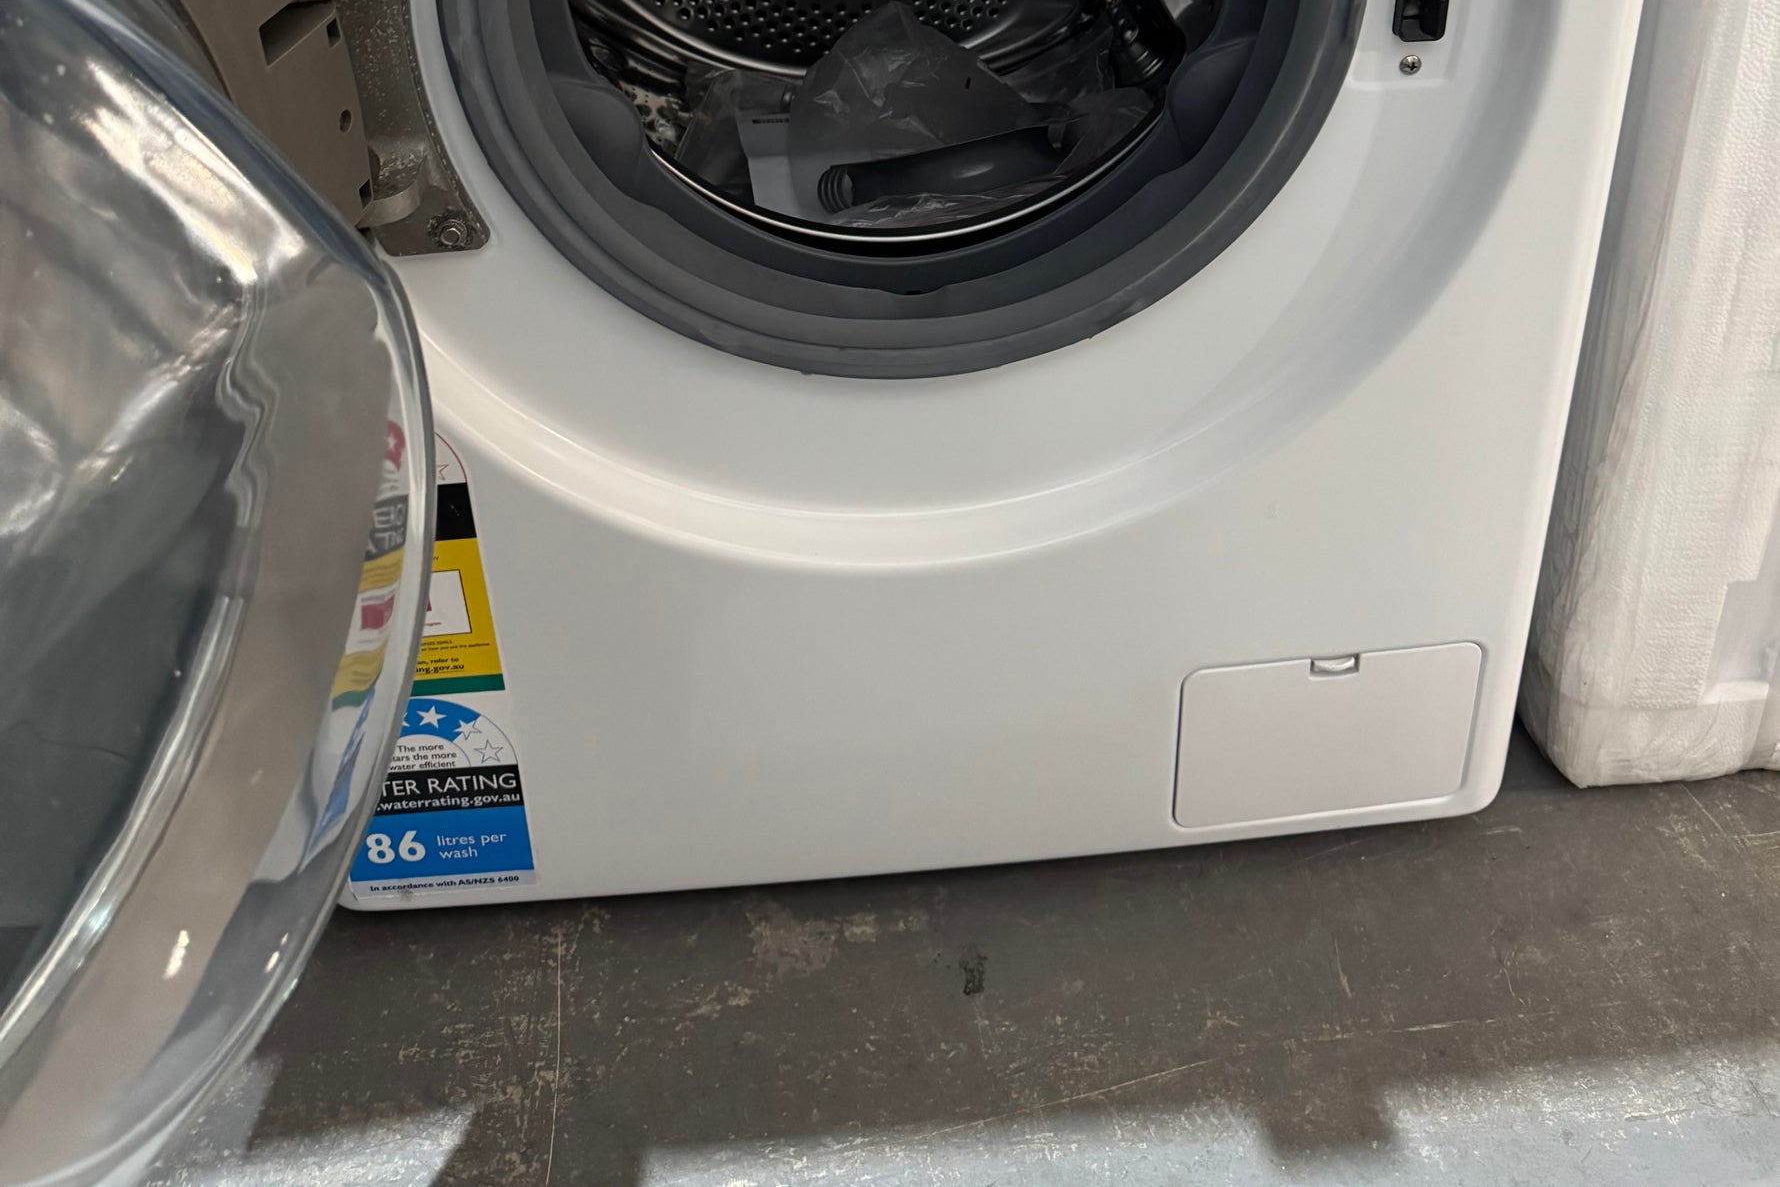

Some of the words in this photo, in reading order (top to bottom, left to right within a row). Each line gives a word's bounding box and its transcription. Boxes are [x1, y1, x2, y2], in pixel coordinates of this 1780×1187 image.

[415, 663, 465, 675] ing.gov.au
[397, 744, 416, 753] The
[418, 744, 445, 752] more
[391, 753, 411, 762] tars
[413, 752, 430, 761] the
[431, 751, 457, 760] more
[389, 763, 416, 771] water
[418, 760, 457, 769] efficient
[381, 778, 421, 797] TER
[427, 772, 517, 794] RATING
[376, 792, 521, 812] .waterrating.gov.au
[436, 834, 476, 847] litres
[481, 832, 507, 846] per
[365, 830, 426, 864] 86
[438, 845, 478, 860] wash
[370, 884, 380, 892] In
[381, 881, 434, 892] accordance
[435, 879, 457, 888] with
